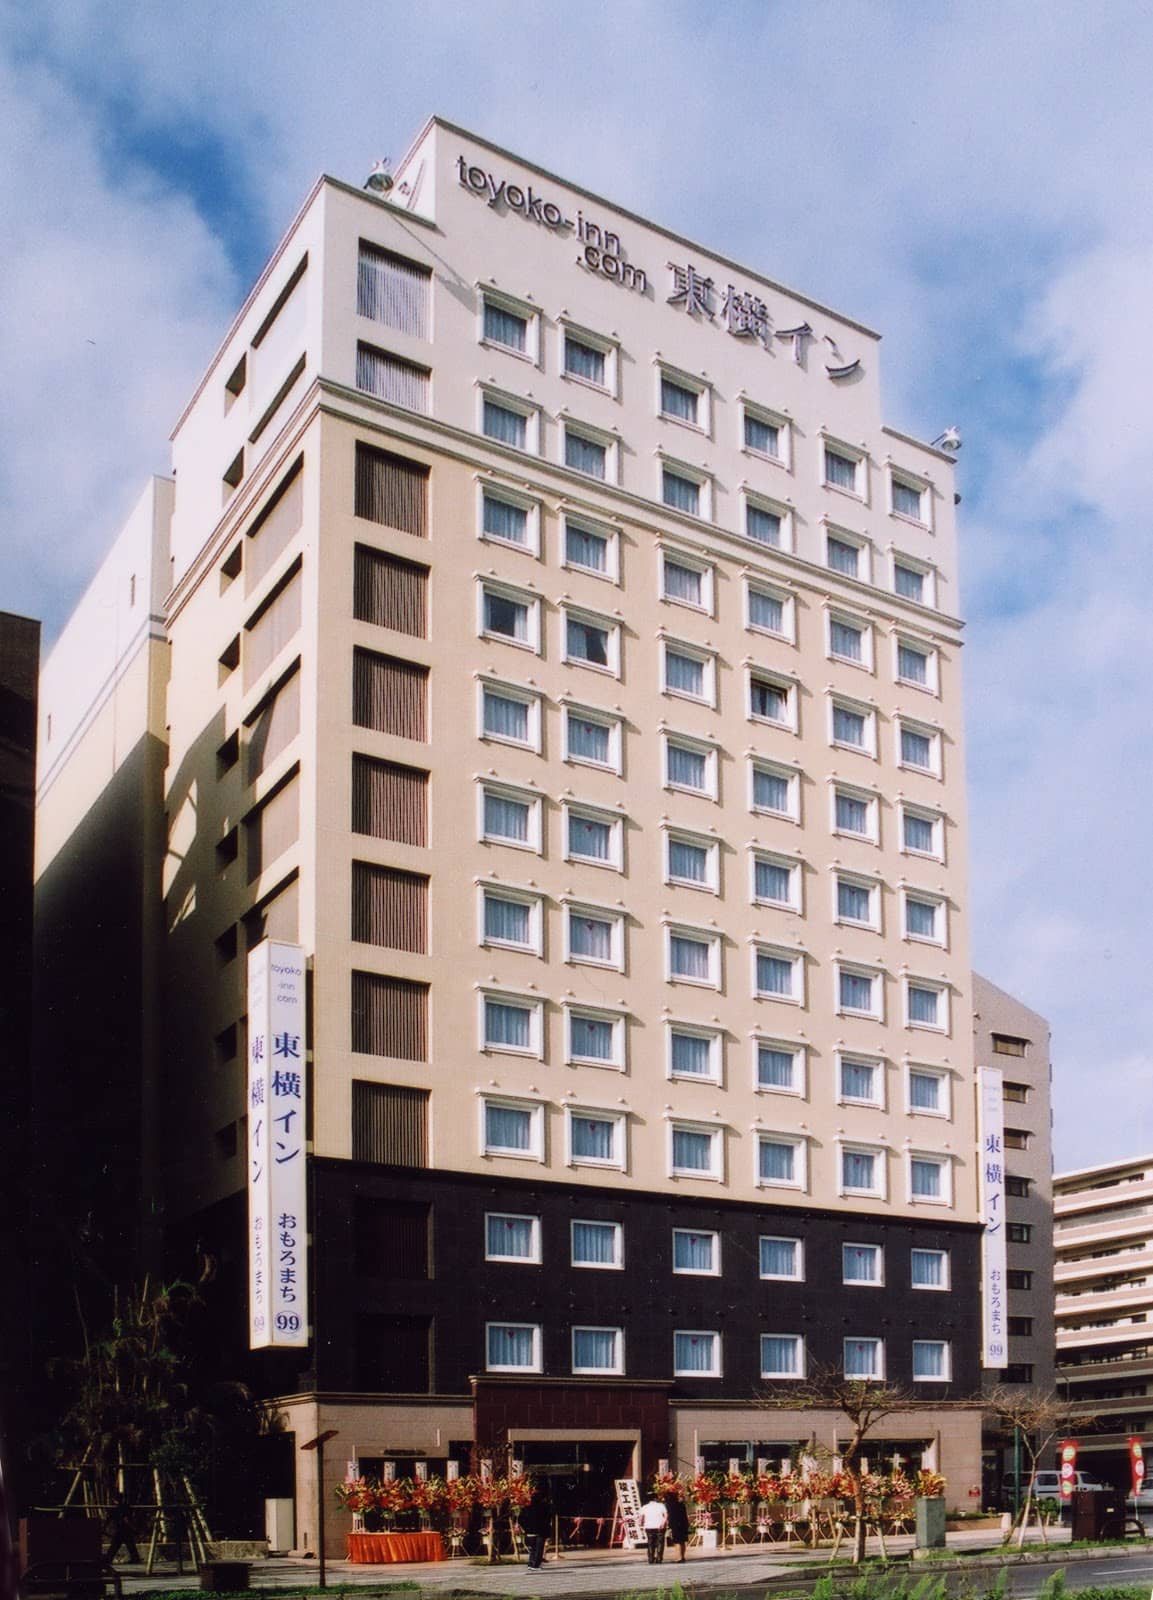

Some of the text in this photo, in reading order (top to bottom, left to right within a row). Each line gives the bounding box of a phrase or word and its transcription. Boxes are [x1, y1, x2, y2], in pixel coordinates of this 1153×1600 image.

[456, 155, 621, 255] toyoko-inn
[665, 260, 860, 379] 東横イン
[271, 1032, 301, 1332] 東横イン おもろまち 99
[986, 1134, 1002, 1232] 東横イン
